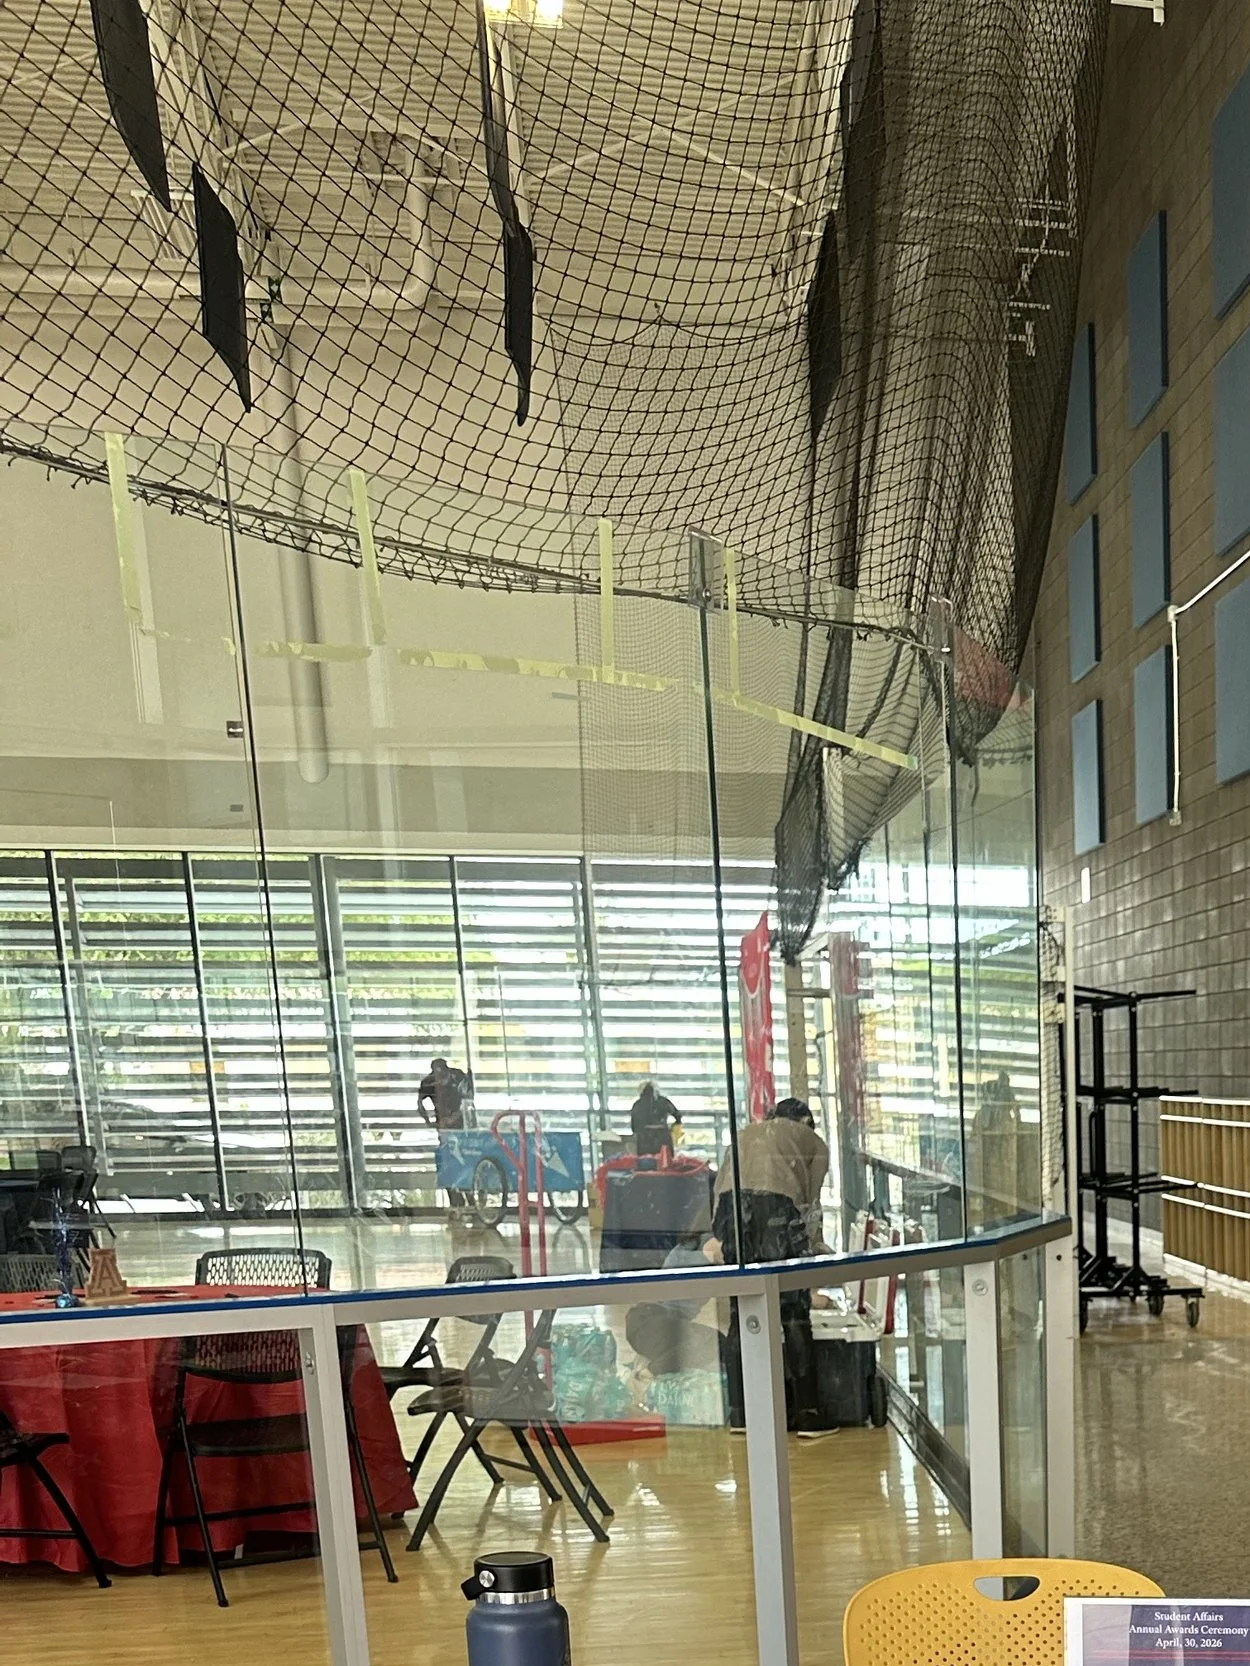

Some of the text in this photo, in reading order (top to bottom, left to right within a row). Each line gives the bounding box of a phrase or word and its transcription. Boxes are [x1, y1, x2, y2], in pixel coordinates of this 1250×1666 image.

[1154, 1611, 1224, 1622] Student Affairs
[1129, 1624, 1249, 1637] Annual Awards Ceremony
[1155, 1638, 1223, 1649] April, 30, 2026
